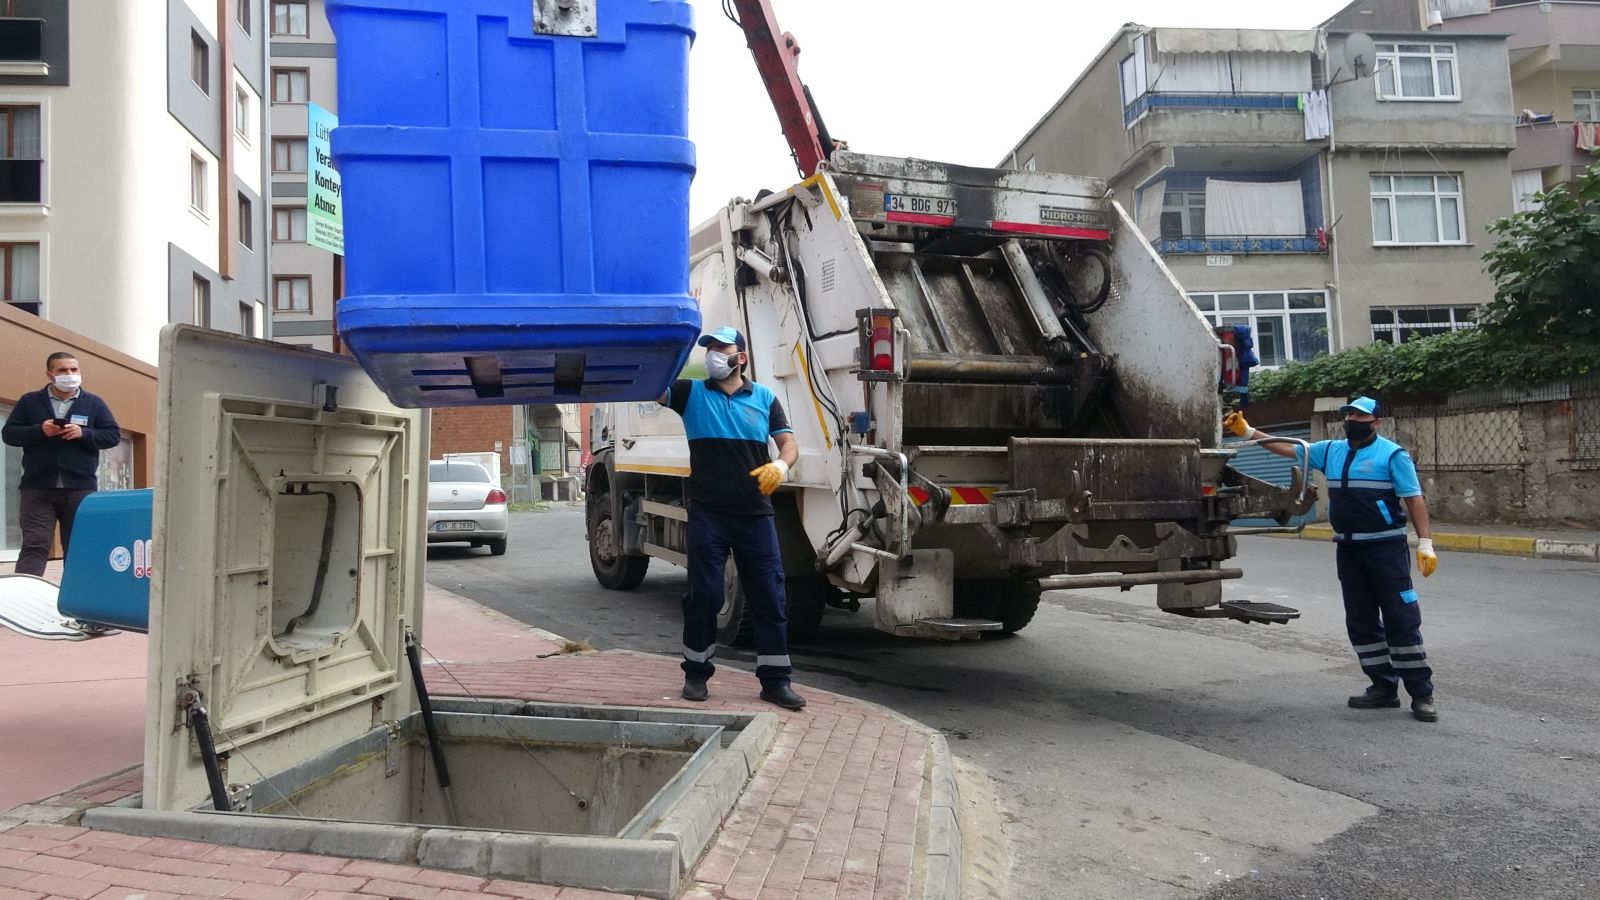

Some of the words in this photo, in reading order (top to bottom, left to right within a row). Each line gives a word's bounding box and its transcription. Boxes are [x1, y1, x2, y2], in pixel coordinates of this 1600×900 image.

[891, 196, 905, 210] 34
[911, 197, 931, 212] BDG
[936, 200, 955, 214] 971
